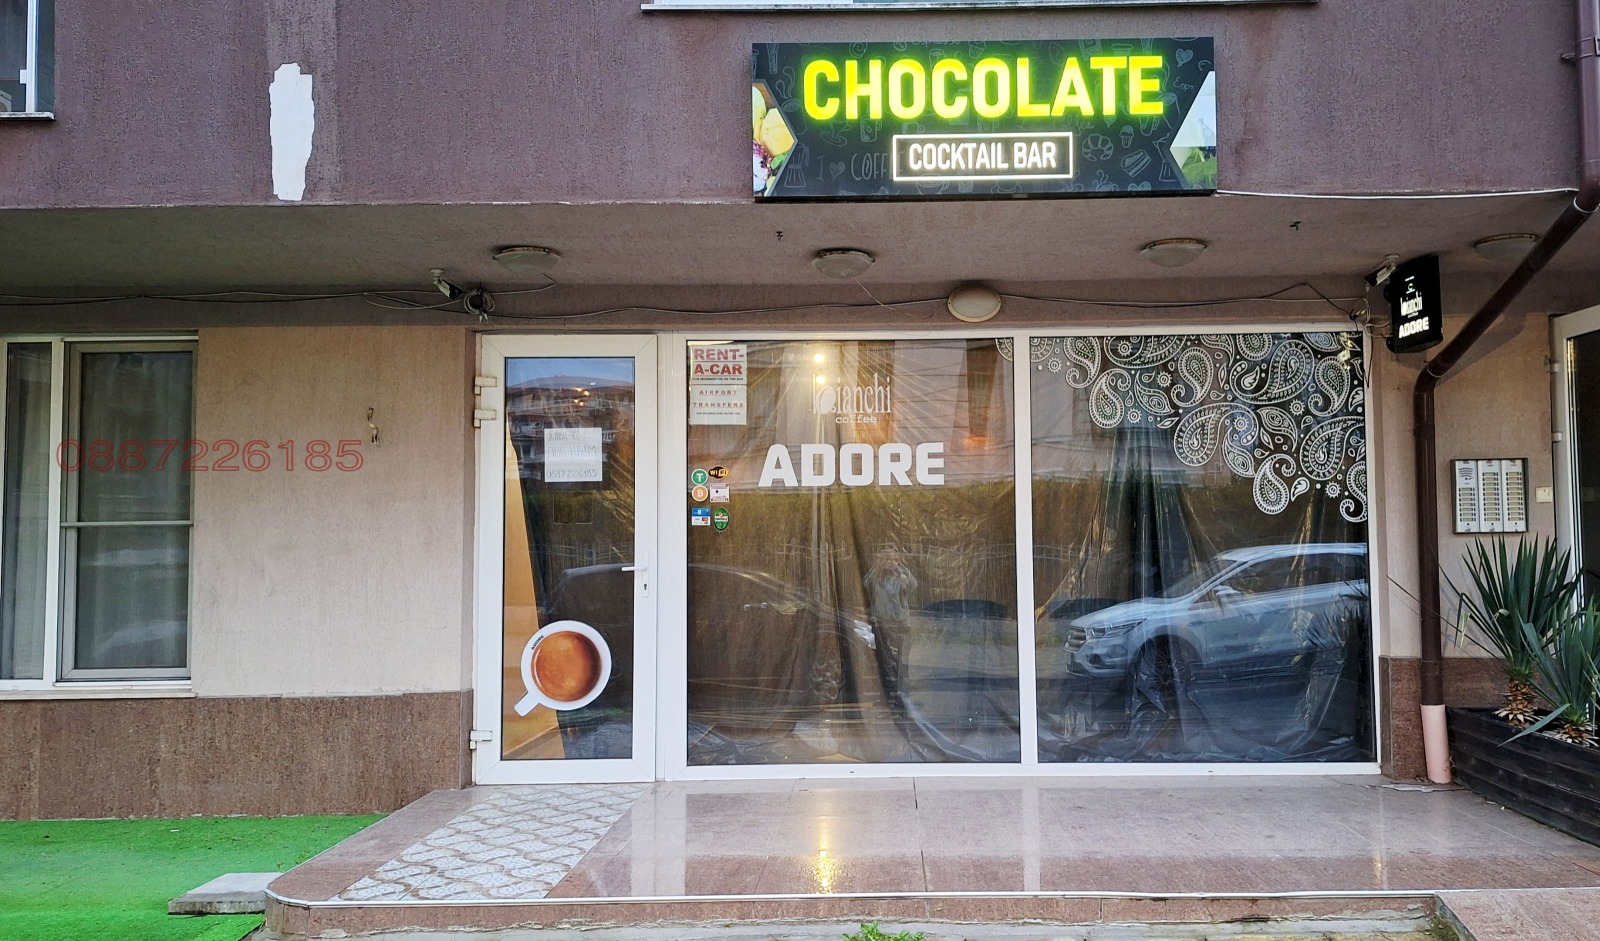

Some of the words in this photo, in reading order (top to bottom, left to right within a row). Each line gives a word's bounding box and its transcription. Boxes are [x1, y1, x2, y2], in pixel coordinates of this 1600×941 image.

[804, 55, 1164, 120] CHOCOLATE
[908, 142, 1009, 171] COCKTAIL
[1012, 140, 1057, 168] BAR
[1399, 316, 1429, 338] ADORE
[693, 349, 744, 361] RENT-
[693, 363, 743, 375] A-CAR
[835, 414, 877, 424] coffee
[758, 442, 945, 487] ADORE
